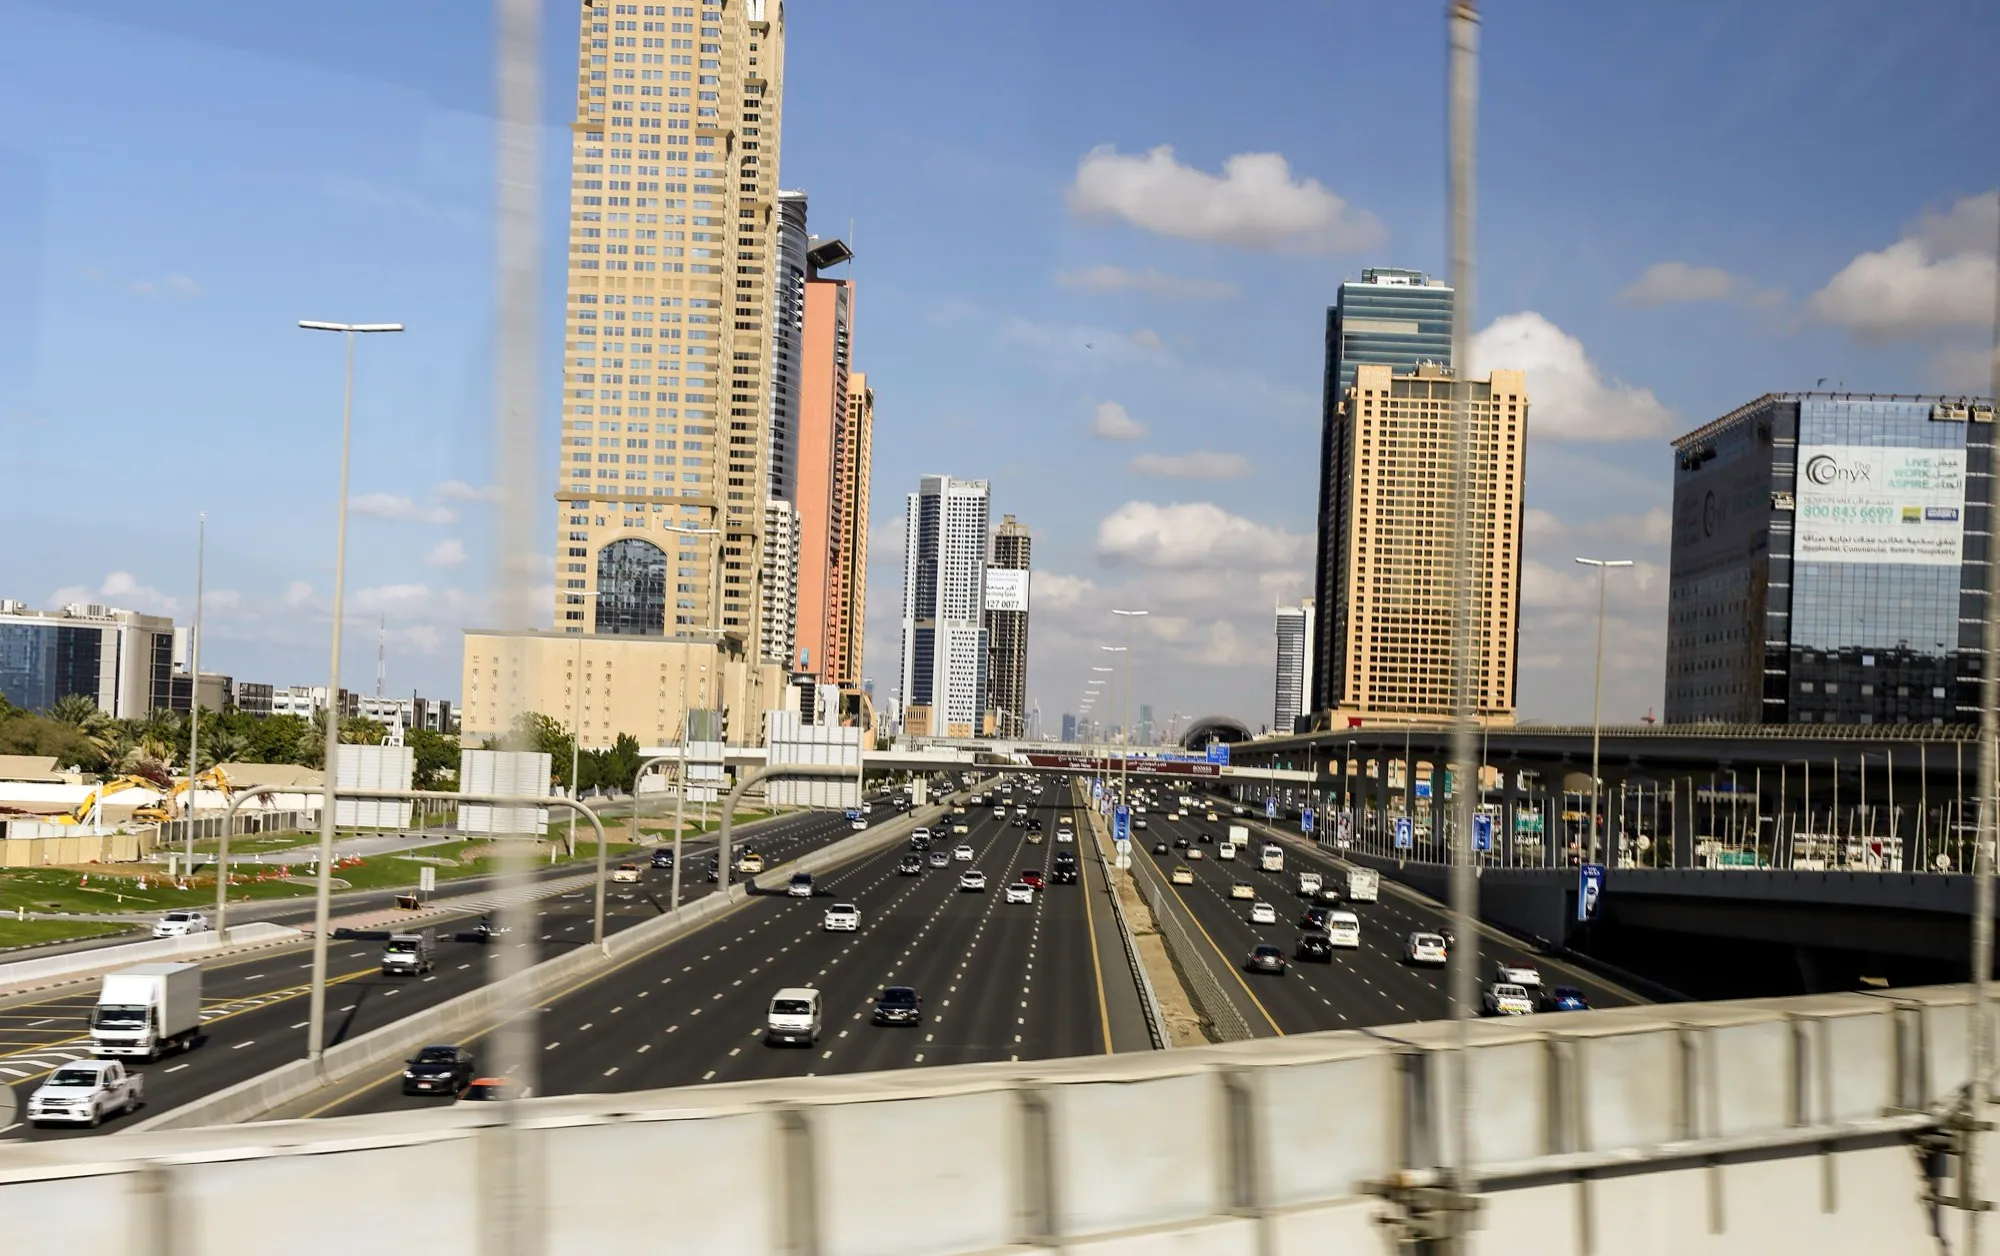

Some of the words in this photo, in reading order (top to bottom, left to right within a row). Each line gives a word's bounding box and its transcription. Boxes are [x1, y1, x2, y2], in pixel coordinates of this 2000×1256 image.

[1894, 468, 1930, 477] WORK
[1887, 479, 1929, 489] ASPIRE
[1804, 505, 1829, 518] 800
[1832, 505, 1857, 518] 843
[1860, 506, 1893, 518] 6699
